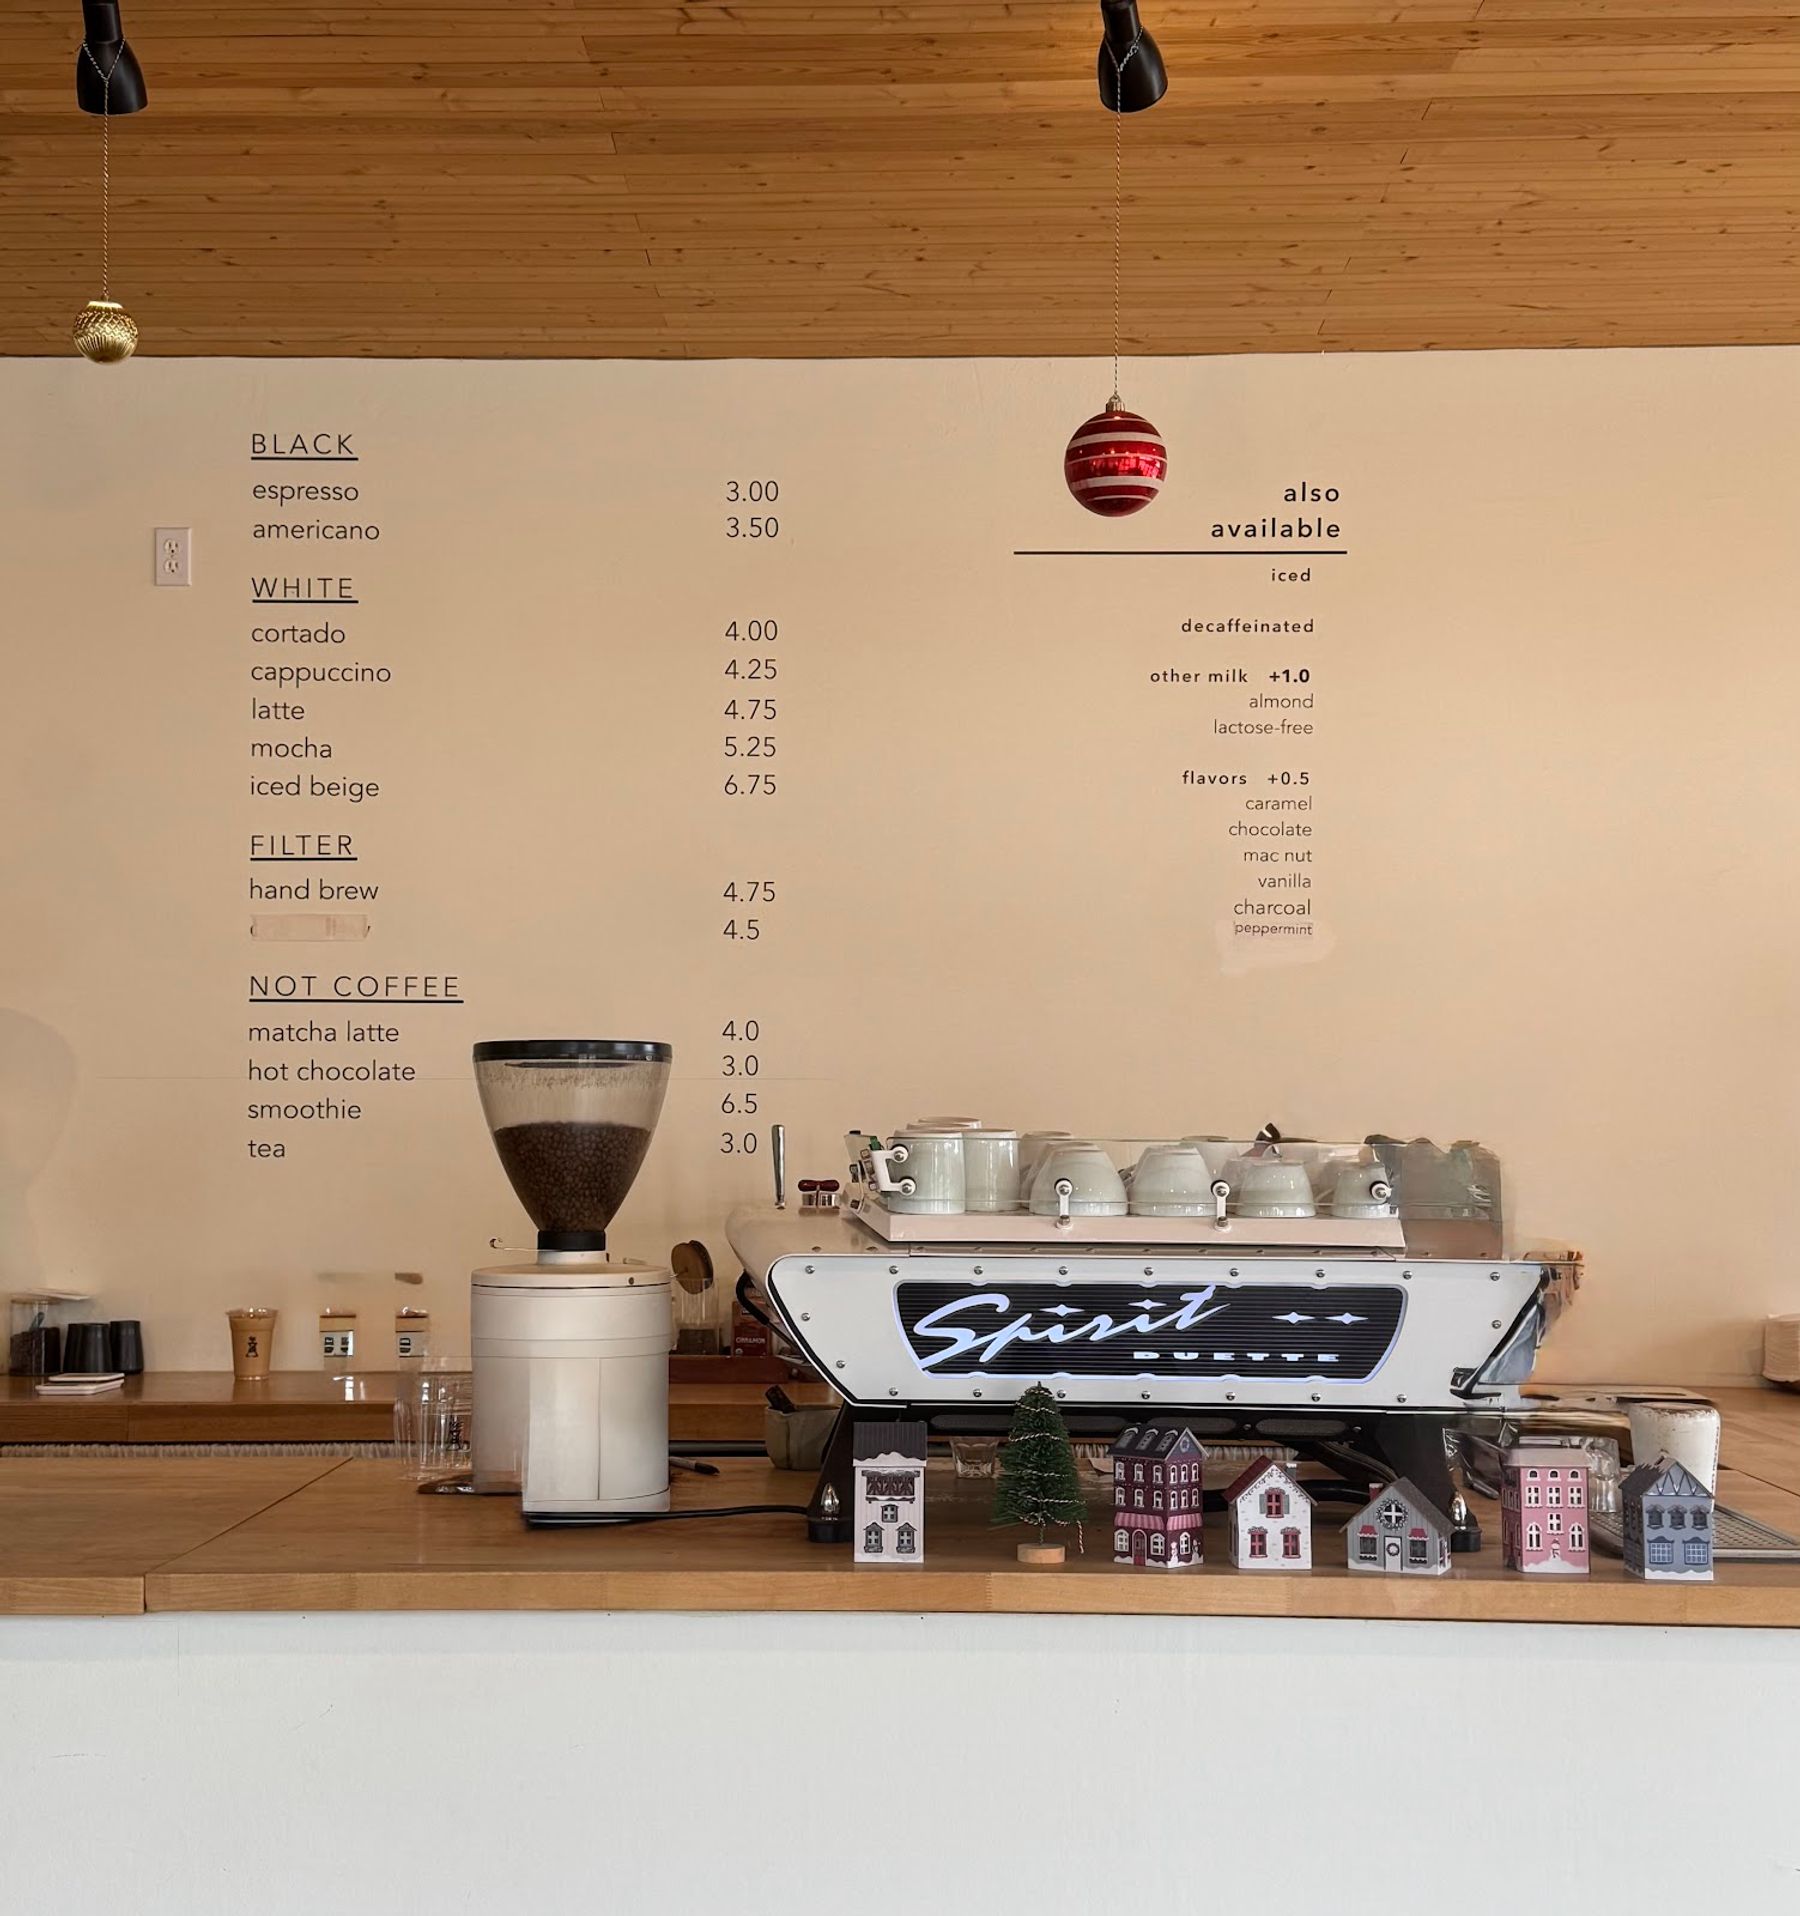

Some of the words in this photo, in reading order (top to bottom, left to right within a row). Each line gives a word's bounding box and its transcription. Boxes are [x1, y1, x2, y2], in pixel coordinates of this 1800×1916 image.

[252, 434, 354, 455] BLACK
[252, 484, 359, 508] espresso
[726, 480, 779, 503] 3.00
[1283, 481, 1340, 503] also
[252, 519, 380, 541] americano
[726, 516, 779, 539] 3.50
[1210, 516, 1341, 539] available
[1271, 567, 1311, 583] iced
[252, 577, 353, 599] WHITE
[251, 621, 346, 644] cortado
[724, 619, 778, 642] 4.00
[1181, 617, 1314, 633] decaffeinated
[250, 661, 392, 689] cappuccino
[724, 658, 778, 680] 4.25
[1150, 667, 1201, 683] other
[1208, 668, 1249, 683] milk
[1268, 668, 1311, 684] +1.0
[252, 697, 305, 721] latte
[723, 698, 777, 720] 4.75
[1249, 692, 1314, 709] almond
[1214, 718, 1314, 735] lactose-free
[251, 735, 332, 759] mocha
[724, 735, 777, 758] 5.25
[724, 773, 777, 796] 6.75
[1181, 769, 1247, 785] flavors
[1267, 771, 1310, 786] +0.5
[250, 774, 301, 797] iced
[310, 774, 380, 804] beige
[1245, 795, 1312, 811] caramel
[1228, 820, 1313, 837] chocolate
[250, 835, 352, 856] FILTER
[1243, 849, 1279, 863] mac
[1284, 849, 1313, 863] nut
[249, 877, 310, 900] hand
[319, 877, 379, 901] brew
[1257, 872, 1312, 889] vanilla
[722, 881, 776, 903] 4.75
[1233, 898, 1311, 916] charcoal
[722, 918, 760, 941] 4.5
[1234, 922, 1313, 938] peppermint
[250, 976, 318, 998] NOT
[334, 976, 459, 998] COFFEE
[248, 1019, 337, 1043] matcha
[347, 1019, 400, 1043] latte
[721, 1019, 760, 1042] 4.0
[248, 1058, 289, 1082] hot
[296, 1058, 416, 1082] chocolate
[722, 1054, 759, 1077] 3.0
[247, 1096, 362, 1120] smoothie
[721, 1092, 758, 1115] 6.5
[247, 1139, 286, 1160] tea
[719, 1131, 758, 1155] 3.0
[913, 1284, 1230, 1370] Spirit
[1133, 1351, 1340, 1362] DUETTE
